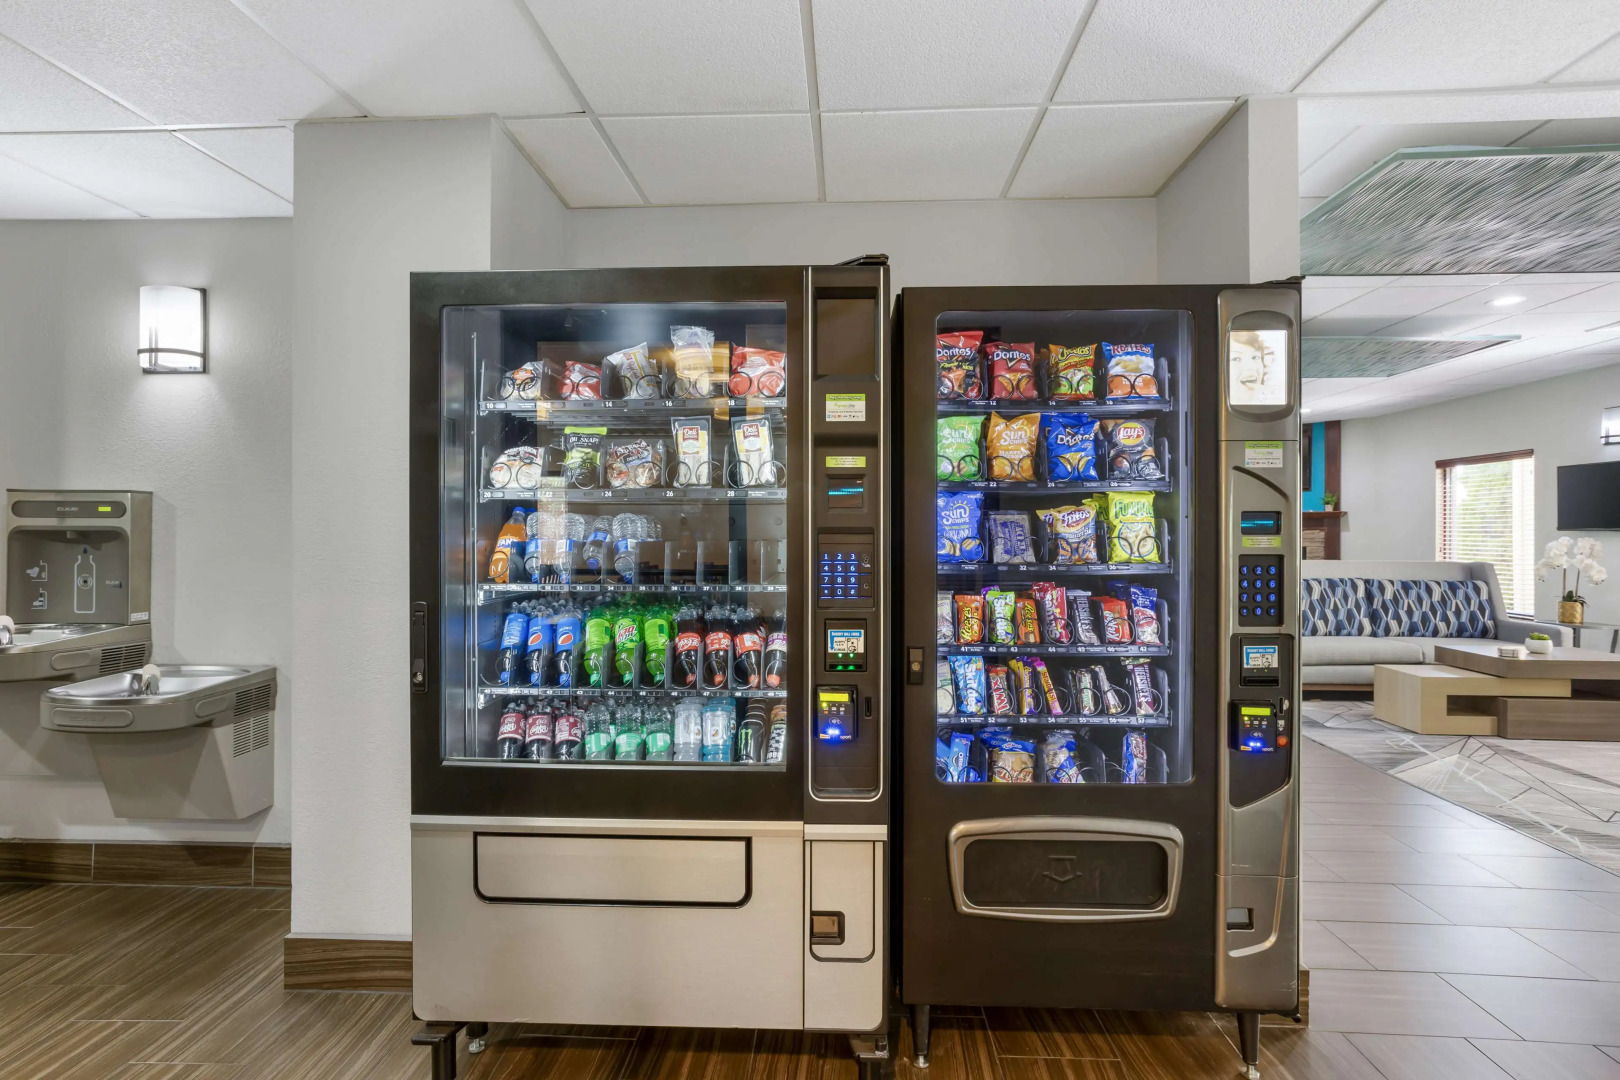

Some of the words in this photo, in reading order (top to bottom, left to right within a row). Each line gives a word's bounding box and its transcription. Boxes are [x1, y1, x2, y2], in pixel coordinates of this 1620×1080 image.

[937, 347, 971, 357] Doritos
[993, 350, 1031, 361] Doritos
[1058, 346, 1090, 360] Cheetos
[683, 428, 698, 436] Deli
[743, 426, 758, 434] Deli
[941, 427, 972, 444] Sun
[1000, 429, 1029, 446] Sun
[1119, 426, 1143, 439] Lay's
[941, 508, 970, 525] Sun
[1060, 510, 1090, 527] Fritos
[1242, 566, 1248, 575] 1
[1256, 566, 1262, 575] 2
[1270, 566, 1276, 575] 3
[1242, 580, 1248, 588] 4
[1256, 580, 1262, 588] 5
[1270, 580, 1276, 588] 6
[1242, 593, 1248, 602] 7
[1256, 593, 1262, 602] 8
[1270, 593, 1276, 602] 9
[1024, 602, 1035, 632] Reese's
[1256, 607, 1262, 615] 0
[960, 606, 972, 641] Reese's
[993, 598, 1007, 640] Skittles
[964, 663, 977, 713] Skittles
[1041, 671, 1057, 702] Starburst
[992, 677, 1011, 715] Twix
